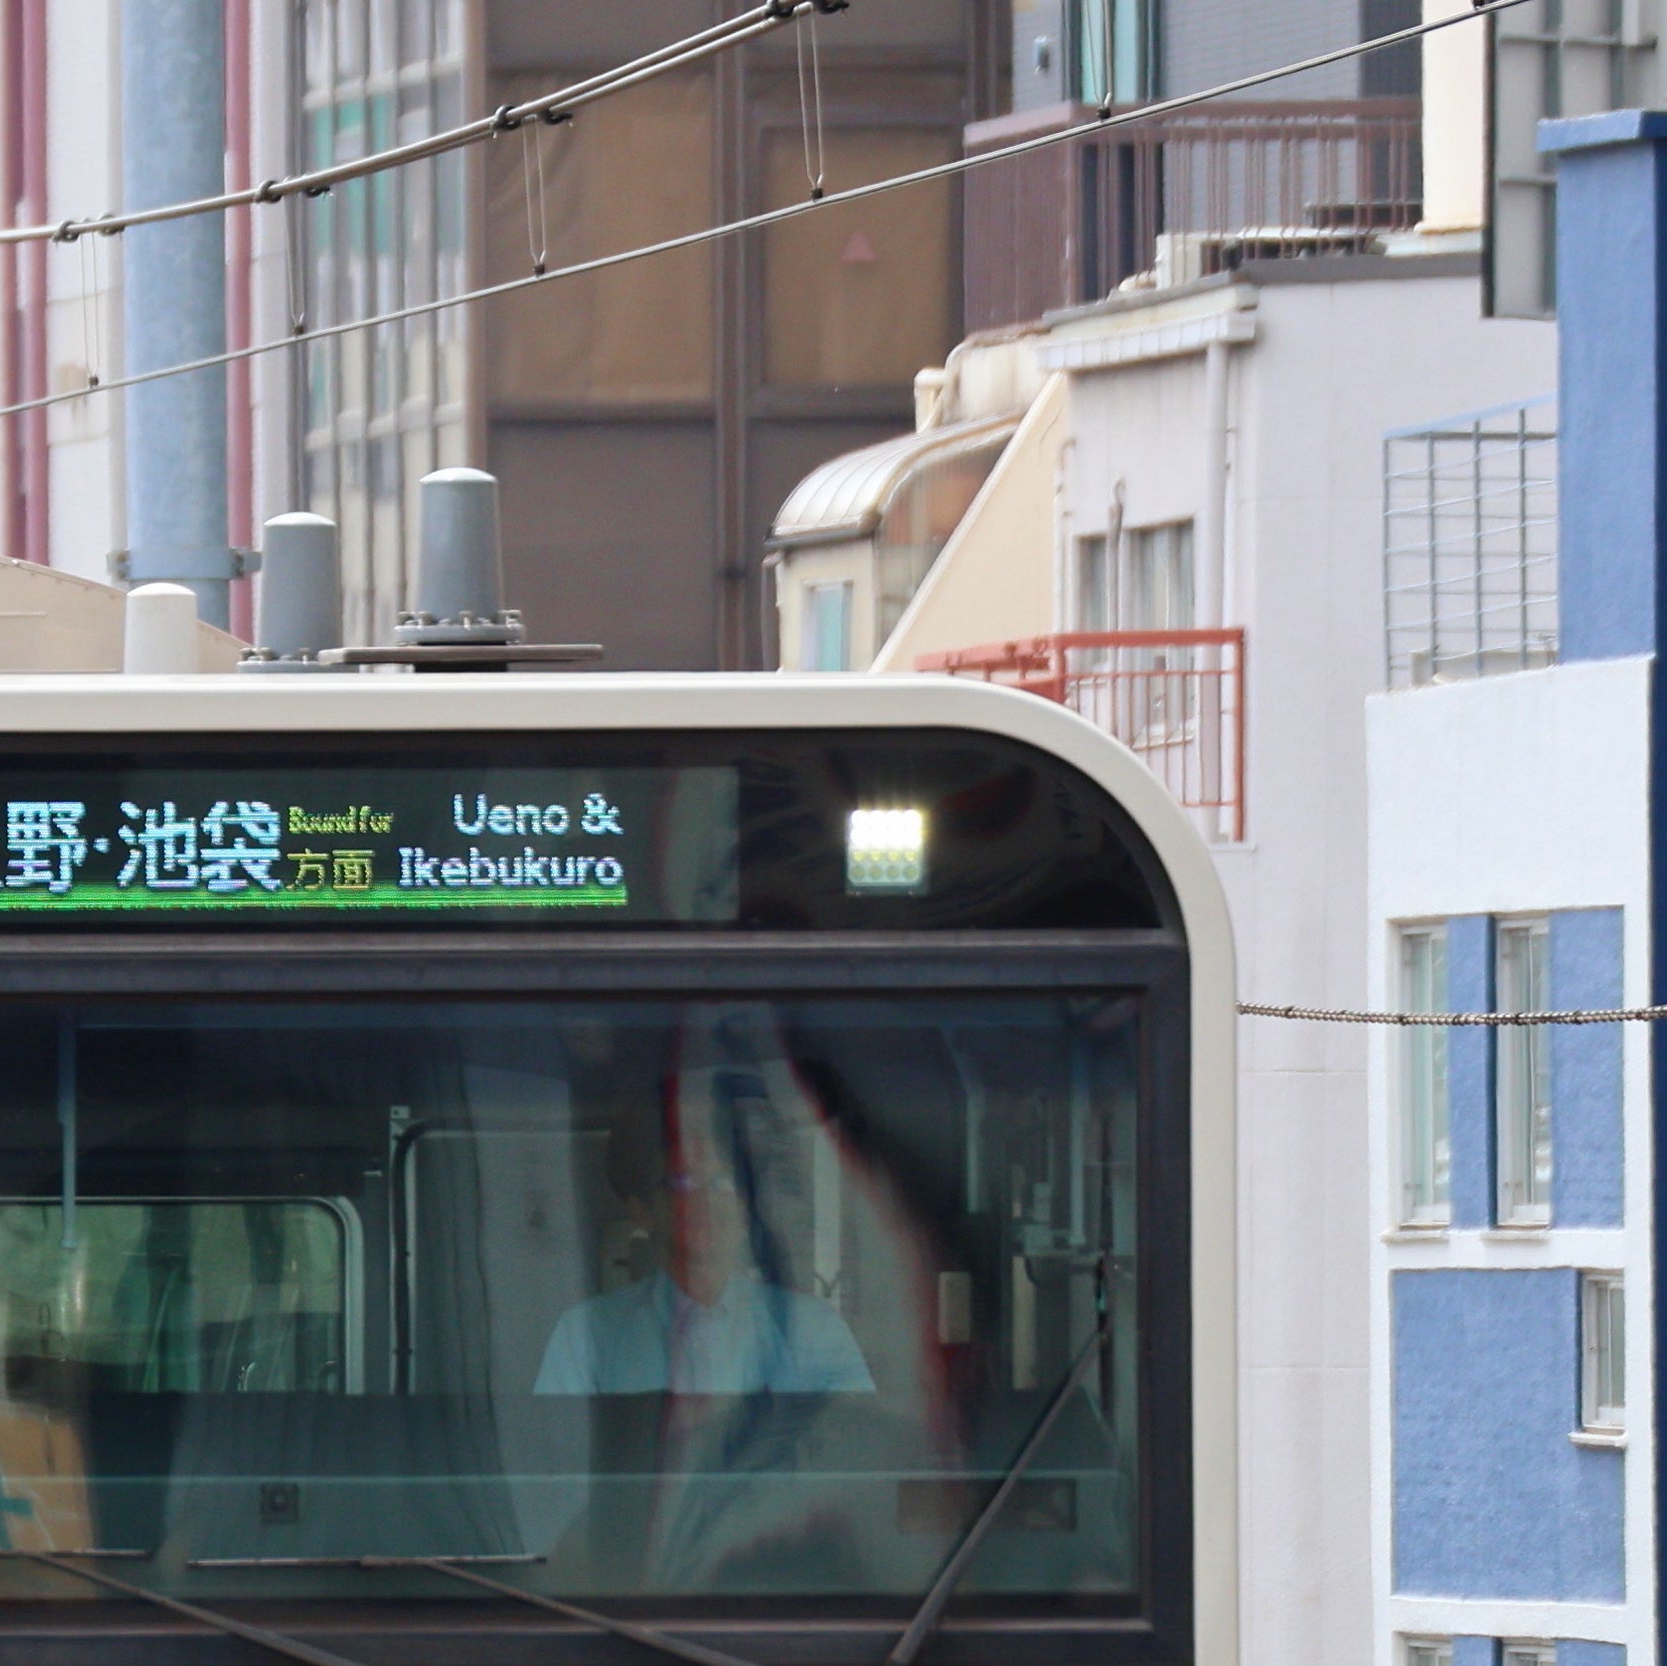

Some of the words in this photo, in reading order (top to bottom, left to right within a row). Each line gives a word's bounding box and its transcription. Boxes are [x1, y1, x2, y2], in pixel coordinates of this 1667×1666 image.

[453, 793, 569, 836] Ueno
[581, 793, 624, 836] &
[286, 849, 375, 890] 方面
[398, 846, 624, 887] Ikebukuro
